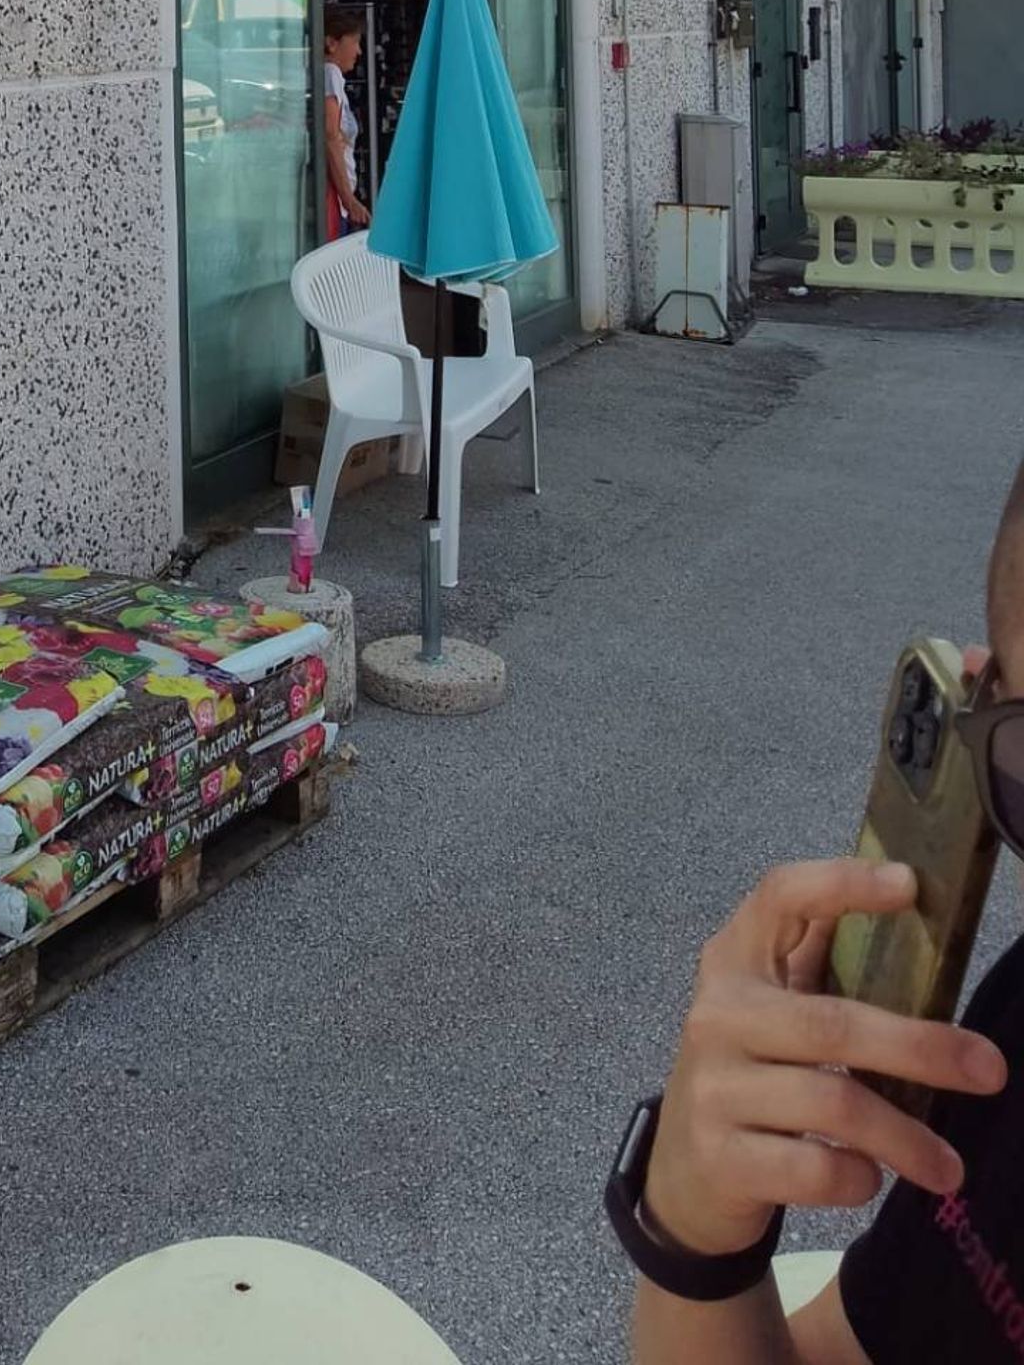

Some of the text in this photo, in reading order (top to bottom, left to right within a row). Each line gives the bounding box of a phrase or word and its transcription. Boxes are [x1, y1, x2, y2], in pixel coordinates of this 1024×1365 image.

[88, 739, 156, 797] NATURA+
[199, 720, 254, 767] NATURA+
[97, 810, 164, 869] NATURA+
